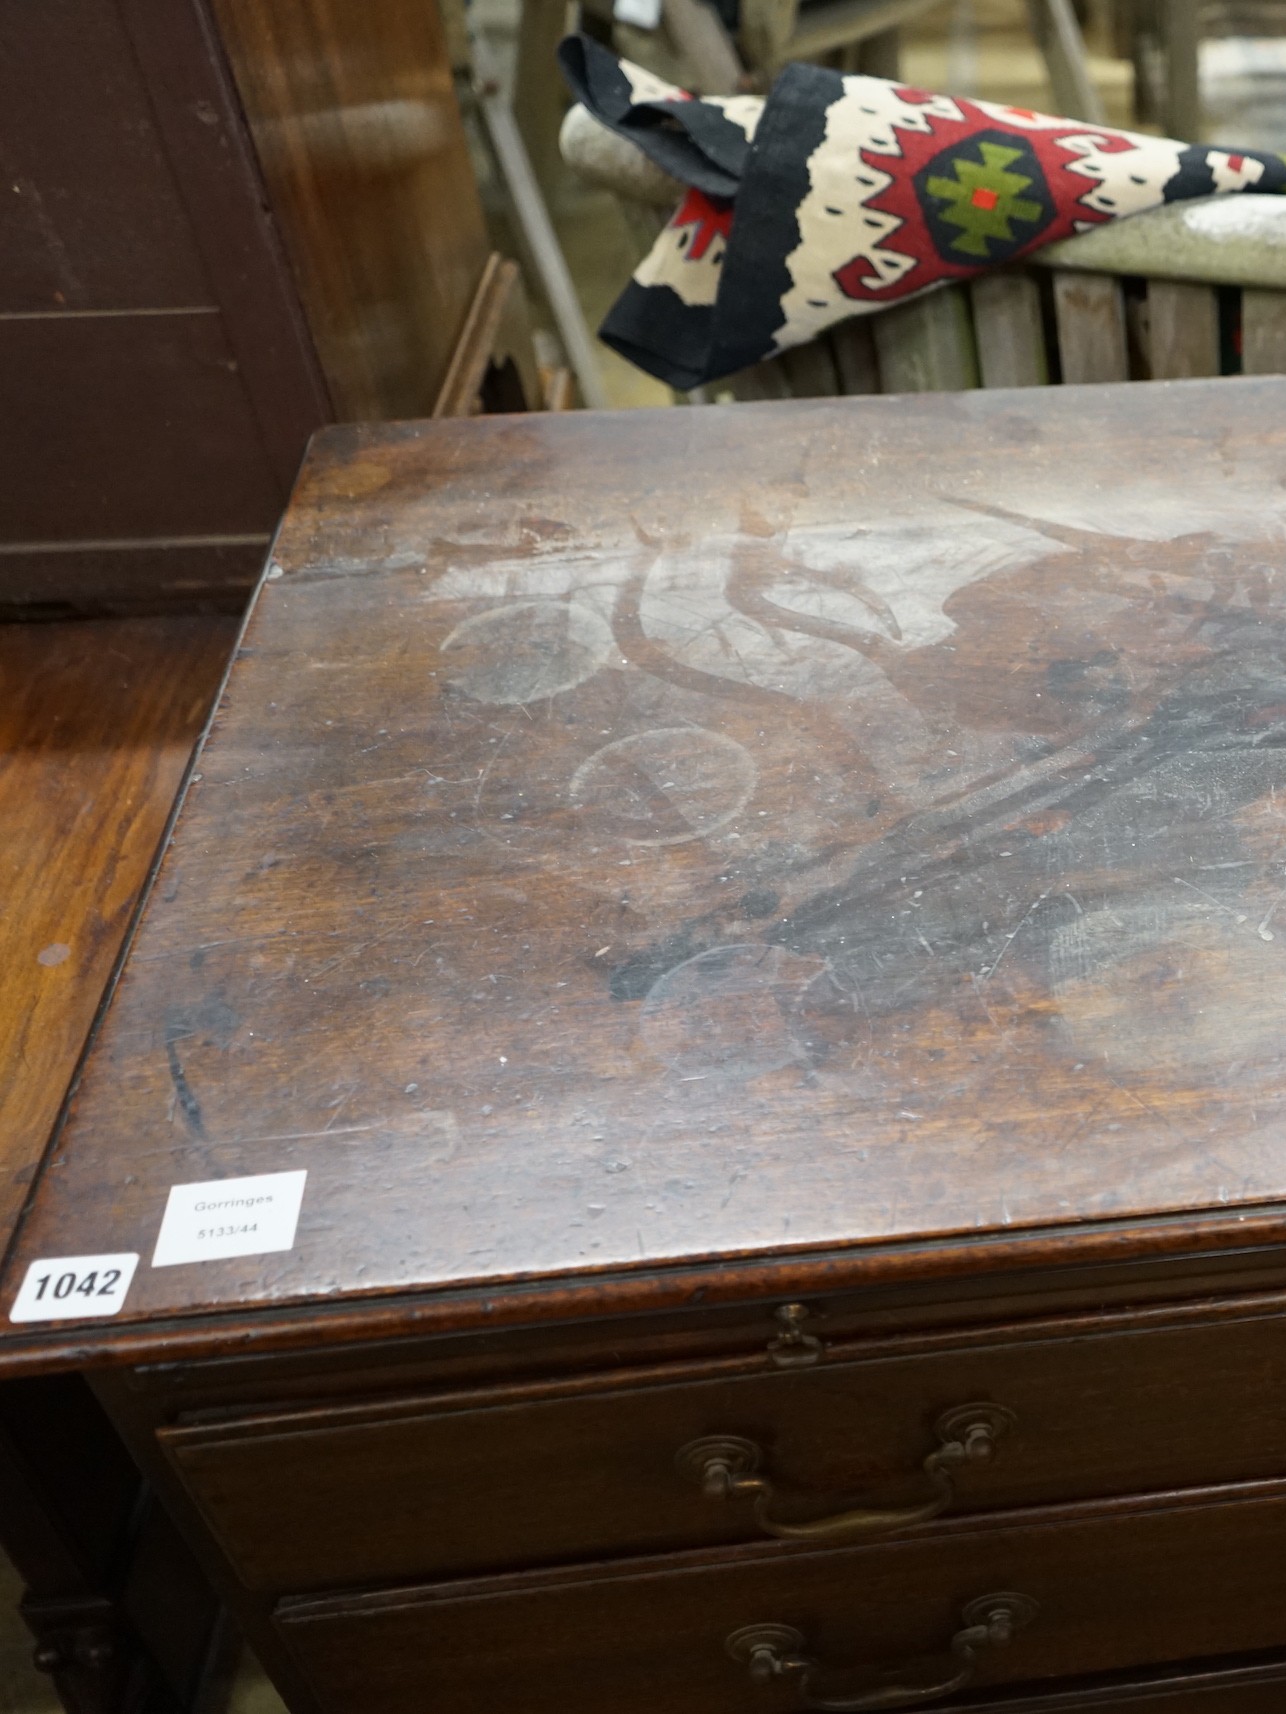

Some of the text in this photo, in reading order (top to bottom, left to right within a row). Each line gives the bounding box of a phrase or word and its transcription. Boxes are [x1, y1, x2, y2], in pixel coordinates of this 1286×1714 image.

[194, 1194, 274, 1212] Gorringes
[196, 1223, 259, 1240] 5133/44
[34, 1269, 122, 1301] 1042
